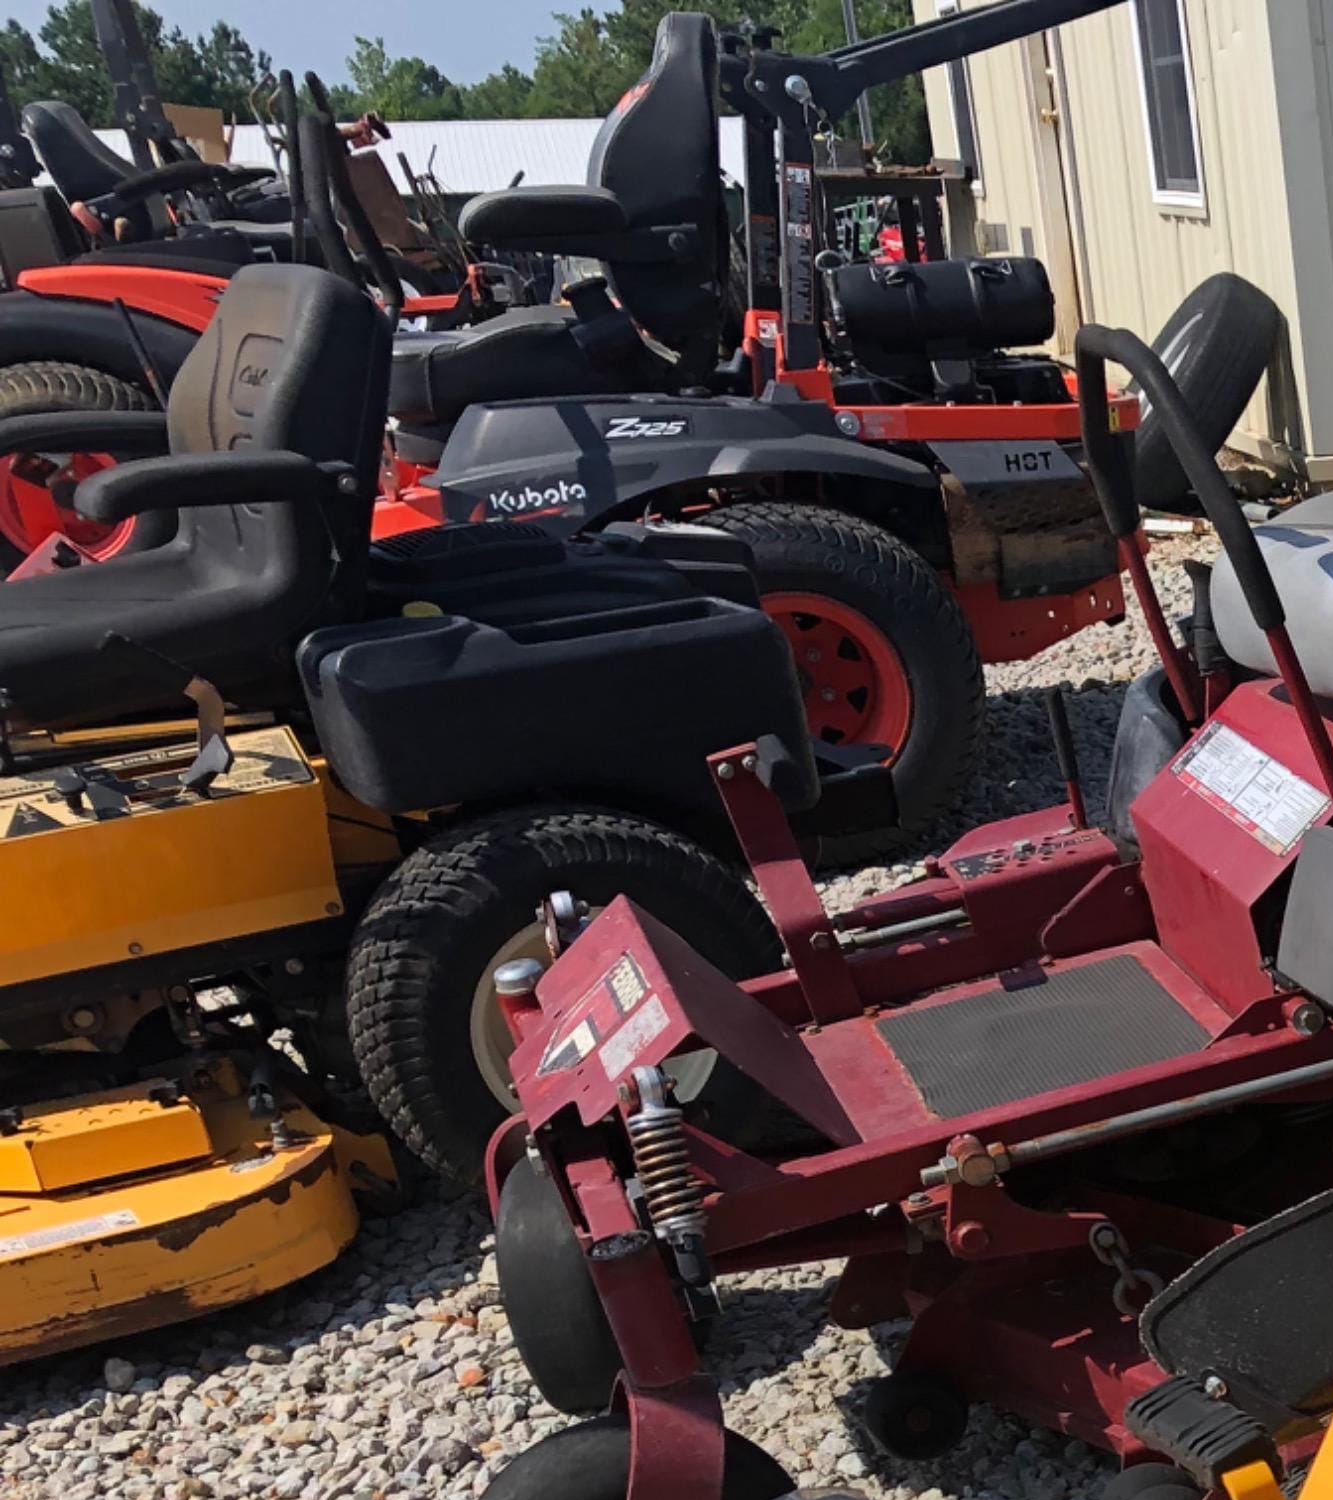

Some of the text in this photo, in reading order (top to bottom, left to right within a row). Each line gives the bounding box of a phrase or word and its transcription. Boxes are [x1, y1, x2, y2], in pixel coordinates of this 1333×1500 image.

[605, 417, 686, 438] Z725
[1004, 451, 1052, 472] HOT
[490, 480, 586, 511] Kubota
